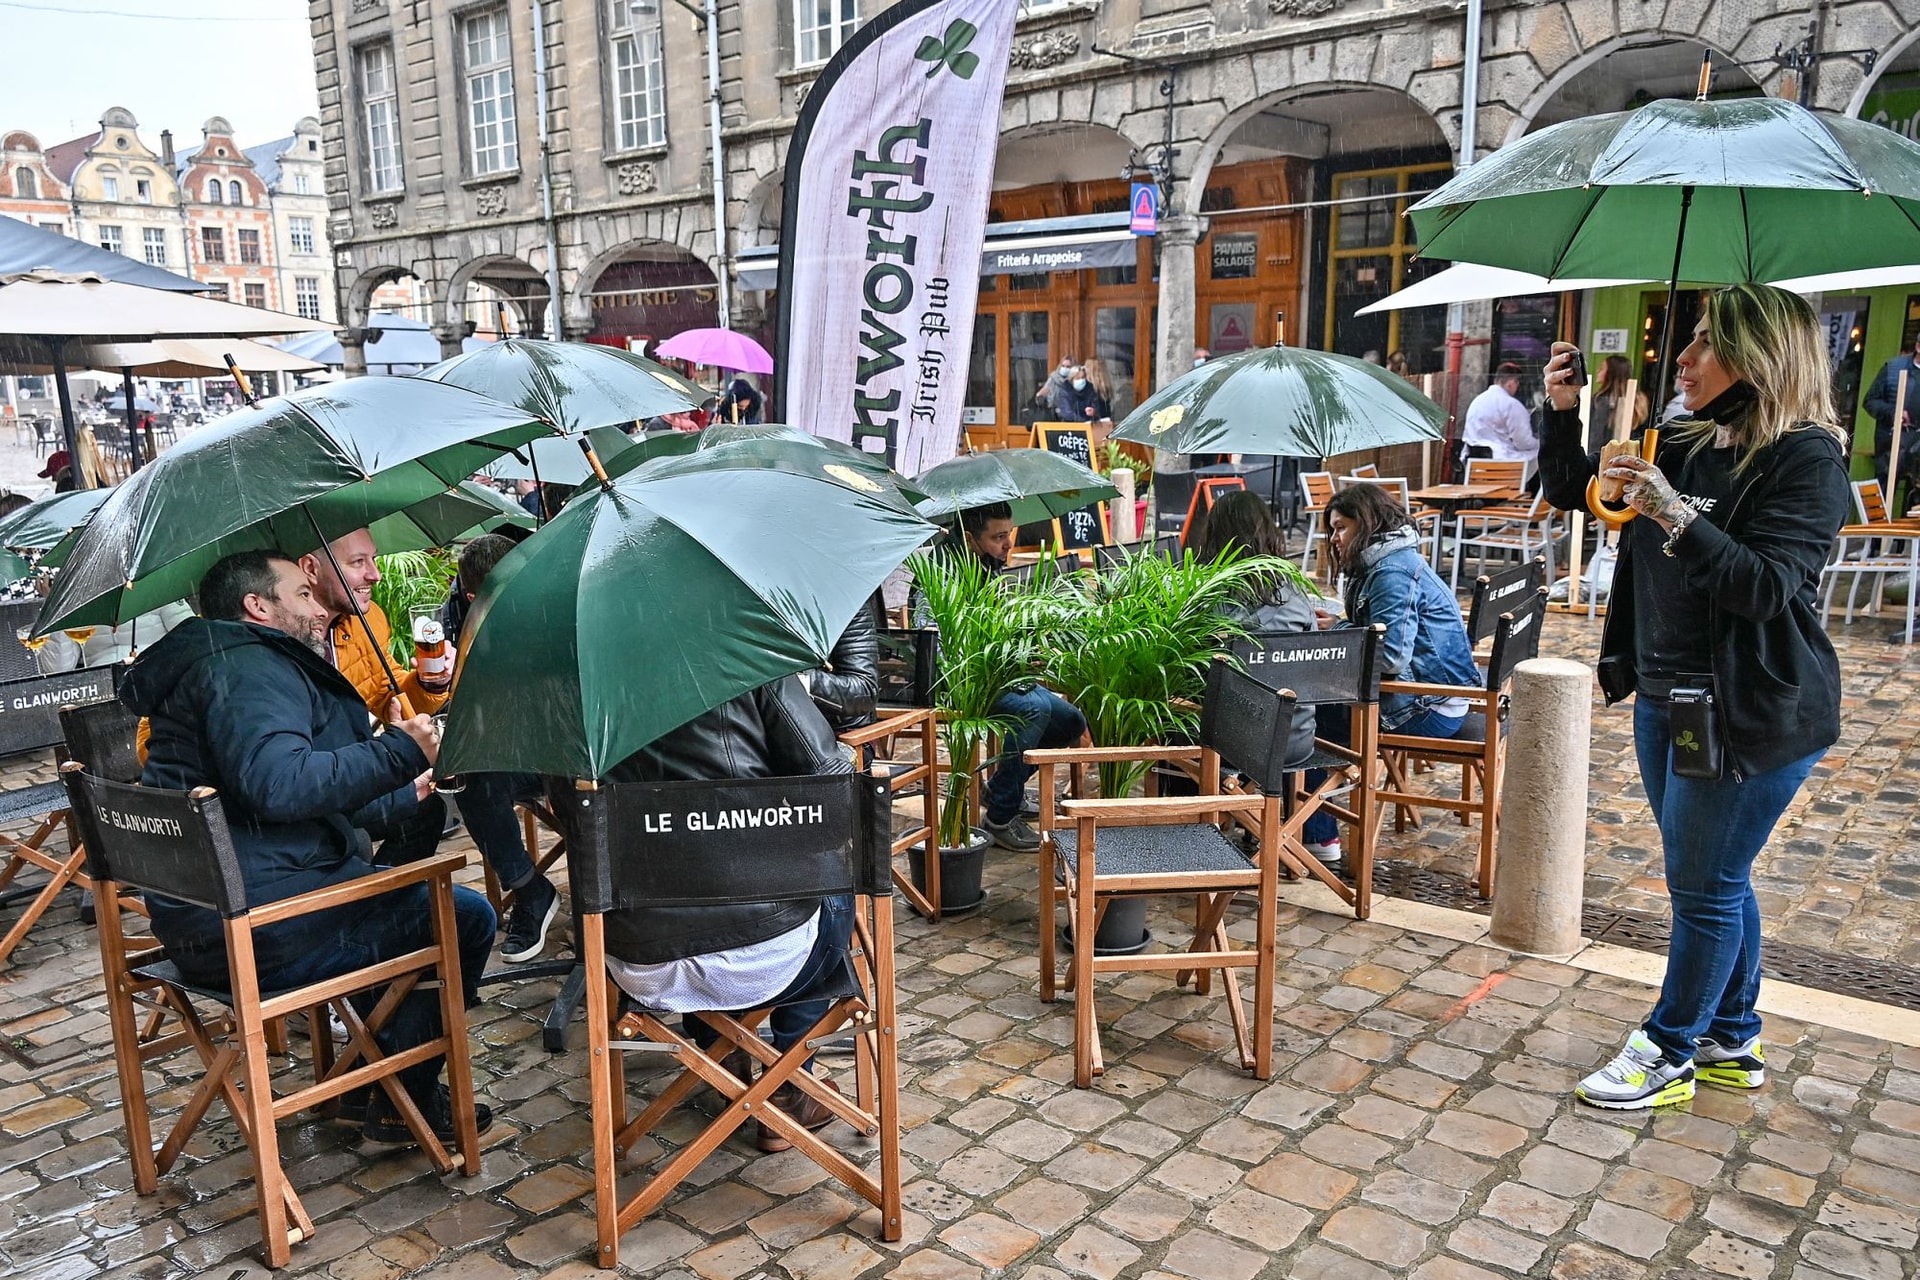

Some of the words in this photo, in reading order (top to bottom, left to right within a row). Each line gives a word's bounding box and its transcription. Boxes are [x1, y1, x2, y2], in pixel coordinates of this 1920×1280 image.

[997, 254, 1031, 268] Friterie
[1032, 249, 1083, 267] Arrageoise
[1213, 240, 1256, 256] PANINIS
[1213, 254, 1256, 268] SALADES
[847, 117, 935, 471] nworth
[918, 276, 951, 341] Pub
[910, 349, 947, 426] Irish
[1068, 511, 1096, 528] PIZZA
[1074, 525, 1089, 542] 8€
[1249, 651, 1266, 664] LE
[1271, 646, 1347, 664] GLANWORTH
[13, 684, 98, 710] GLANWORTH
[96, 804, 110, 824] LE
[111, 810, 183, 837] GLANWORTH
[644, 812, 673, 833] LE
[686, 804, 823, 832] GLANWORTH
